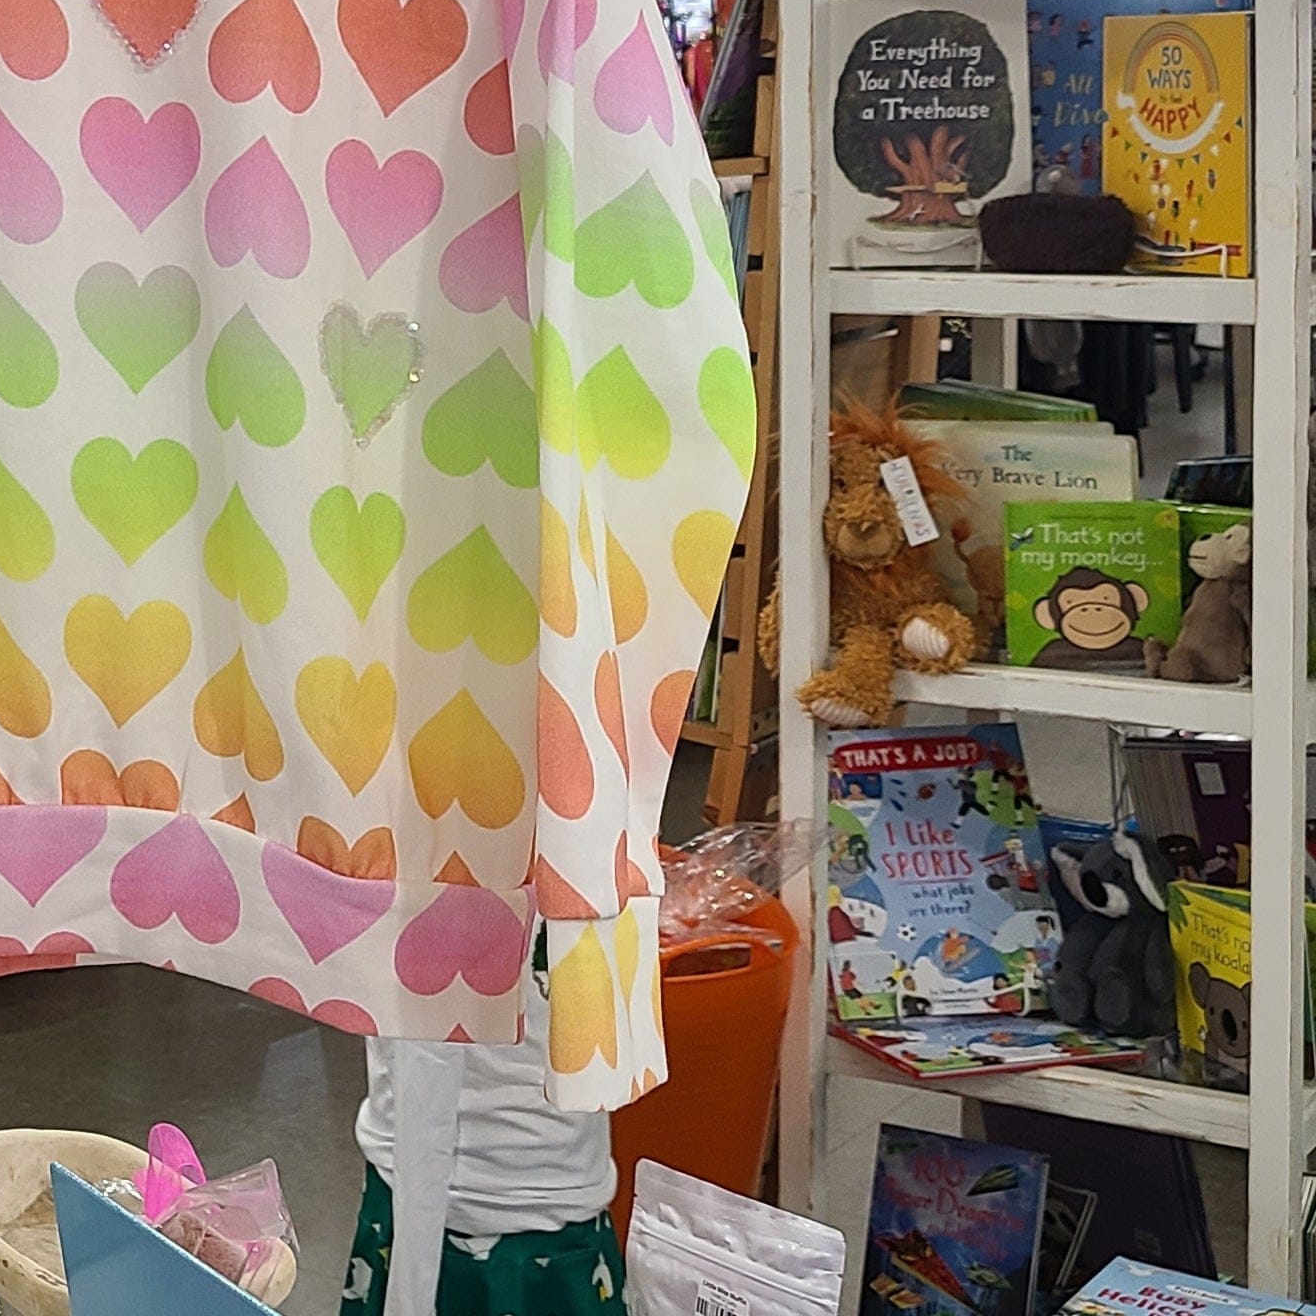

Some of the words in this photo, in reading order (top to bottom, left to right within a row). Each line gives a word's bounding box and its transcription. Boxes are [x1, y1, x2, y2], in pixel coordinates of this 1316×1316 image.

[870, 37, 982, 66] Everything
[1161, 45, 1183, 66] 50
[857, 69, 891, 91] You
[898, 66, 953, 89] Need
[961, 66, 996, 88] for
[1147, 69, 1192, 90] WAYS
[861, 106, 875, 120] a
[879, 96, 990, 121] Treehouse
[1139, 96, 1202, 133] HAPPY
[1001, 444, 1033, 461] The
[992, 467, 1045, 486] Brave
[1054, 470, 1098, 490] Lion
[1038, 523, 1102, 544] That's
[1108, 528, 1145, 545] not
[1021, 550, 1055, 571] my
[840, 746, 908, 769] THAT'S
[912, 744, 928, 763] A
[933, 742, 980, 763] JOB?
[885, 820, 897, 846] I
[880, 848, 975, 879] SPORTS
[1191, 911, 1230, 945] That's
[1191, 939, 1211, 965] my
[1137, 1286, 1208, 1311] Busy
